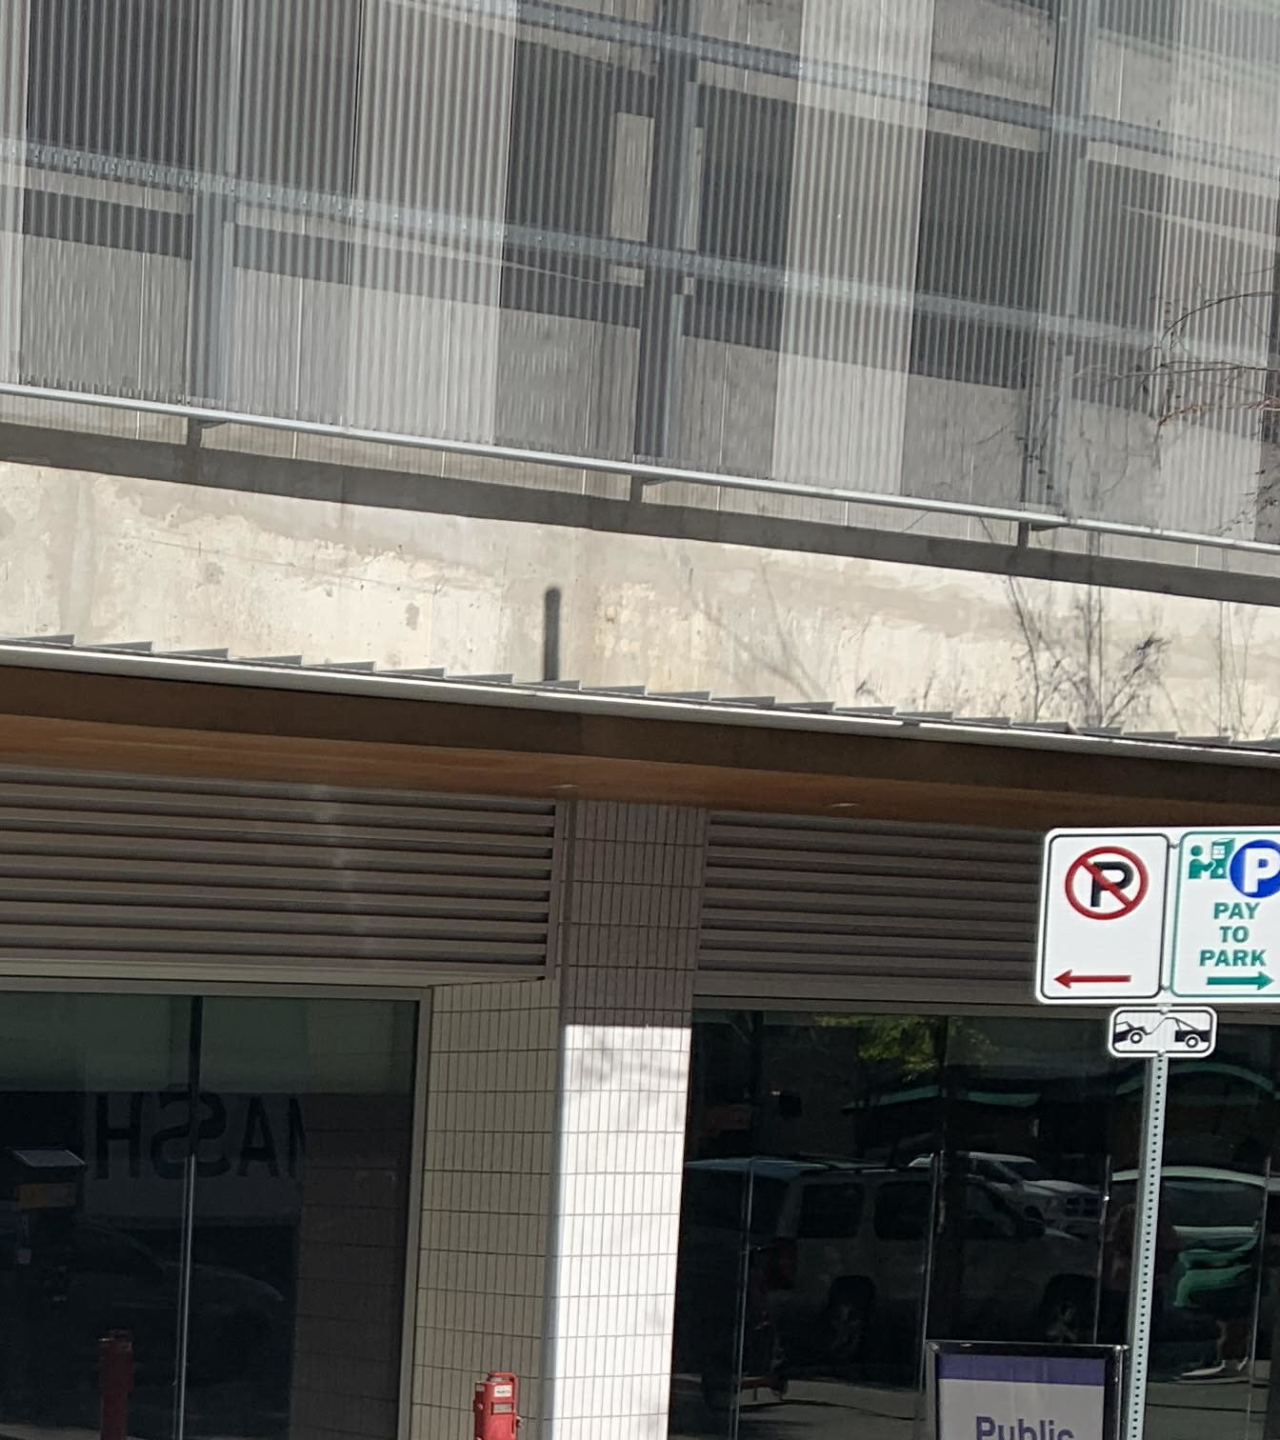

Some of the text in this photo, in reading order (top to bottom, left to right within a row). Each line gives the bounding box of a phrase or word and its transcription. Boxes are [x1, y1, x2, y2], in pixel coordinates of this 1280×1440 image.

[1213, 902, 1260, 920] PAY
[1219, 925, 1250, 943] TO
[1199, 949, 1267, 967] PARK
